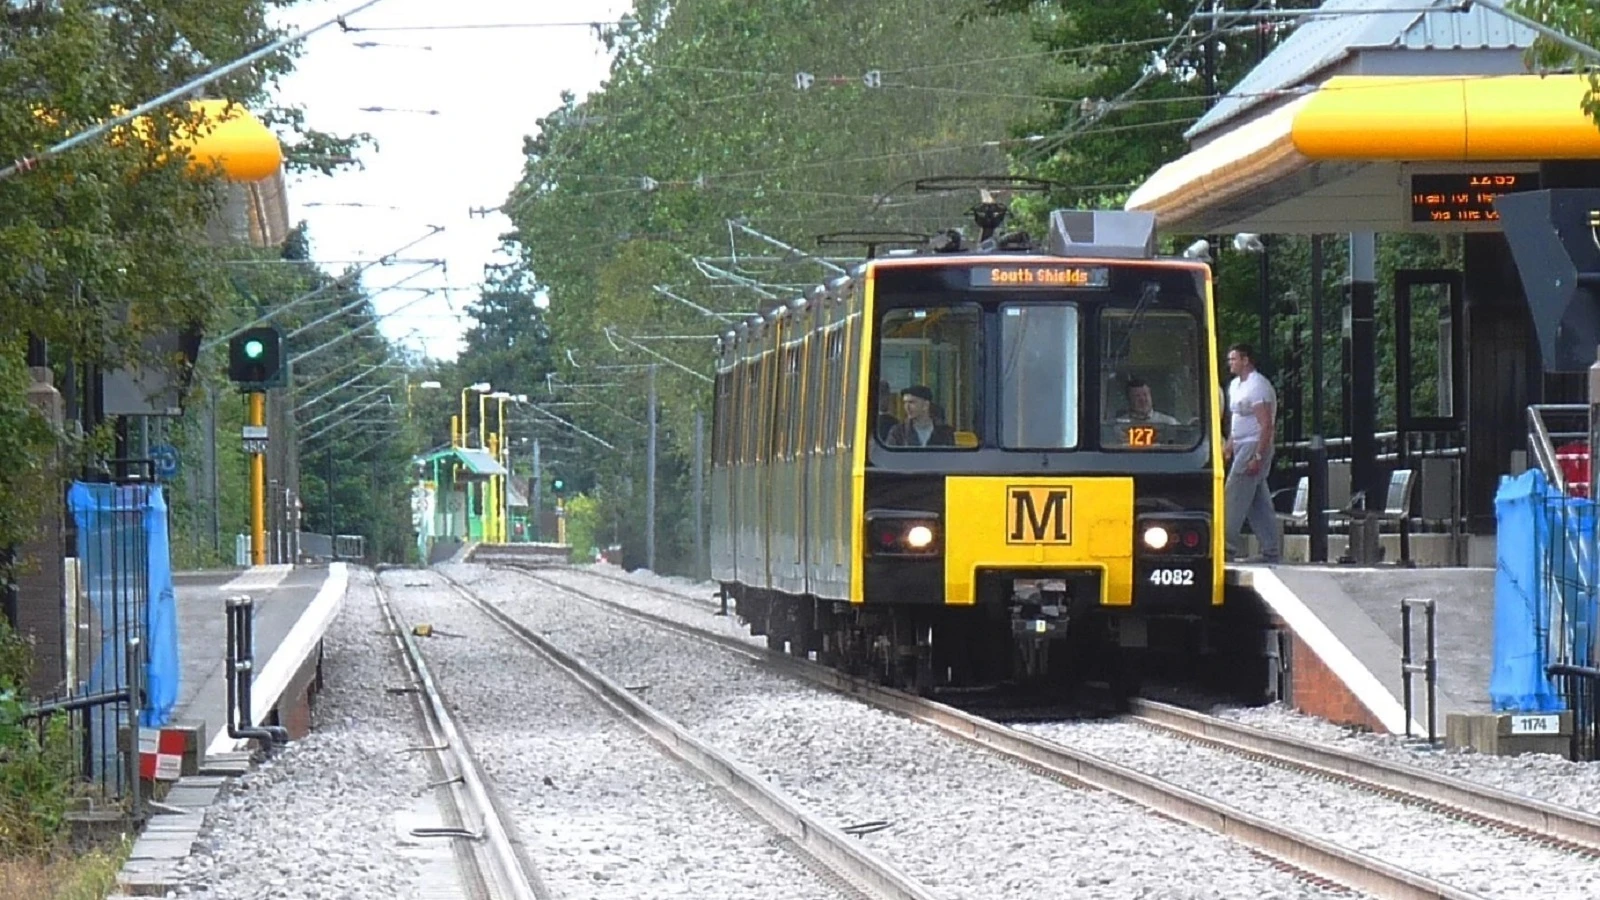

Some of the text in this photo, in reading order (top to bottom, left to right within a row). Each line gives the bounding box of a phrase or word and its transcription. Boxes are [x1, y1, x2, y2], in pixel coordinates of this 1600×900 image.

[991, 268, 1088, 282] South Shields
[1128, 427, 1154, 446] 127
[1010, 490, 1068, 541] M
[1149, 568, 1195, 586] 4082
[1520, 717, 1548, 731] 1174
